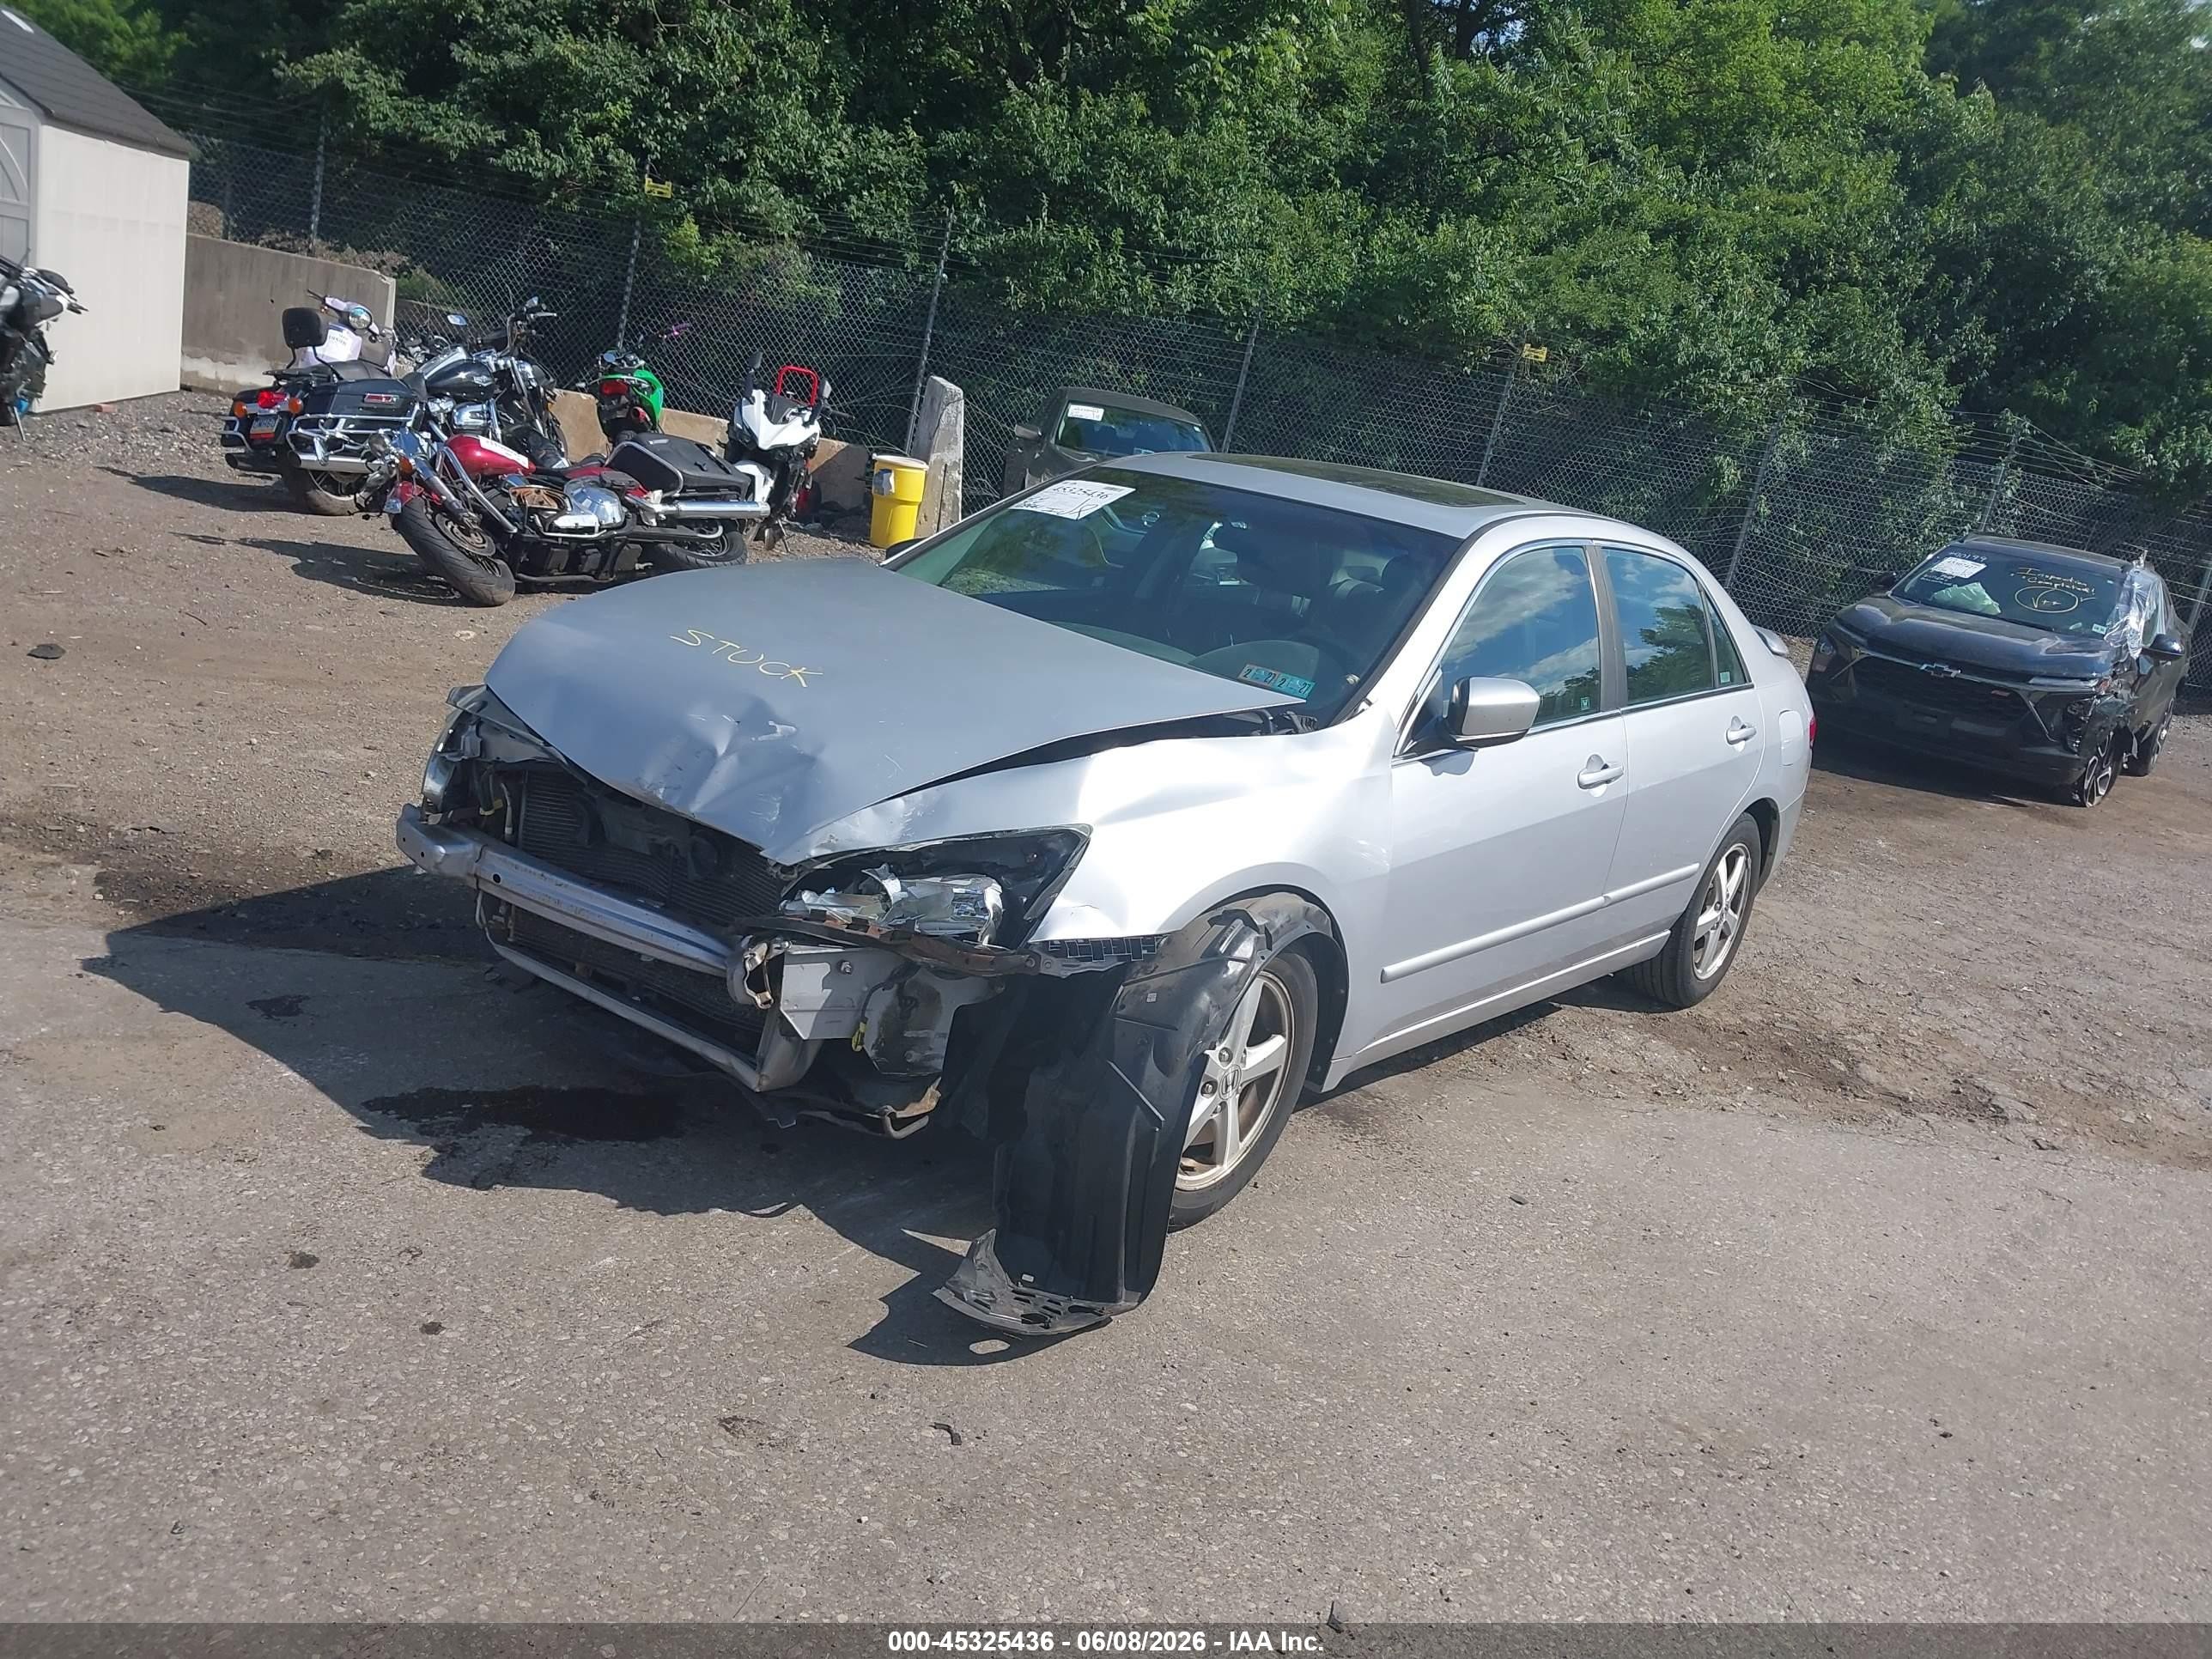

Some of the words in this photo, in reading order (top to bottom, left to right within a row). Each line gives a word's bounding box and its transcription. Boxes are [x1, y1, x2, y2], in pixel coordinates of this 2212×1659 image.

[669, 629, 823, 688] STUCK
[1243, 668, 1252, 678] 2
[1277, 678, 1286, 689] 2
[1298, 682, 1311, 695] 27
